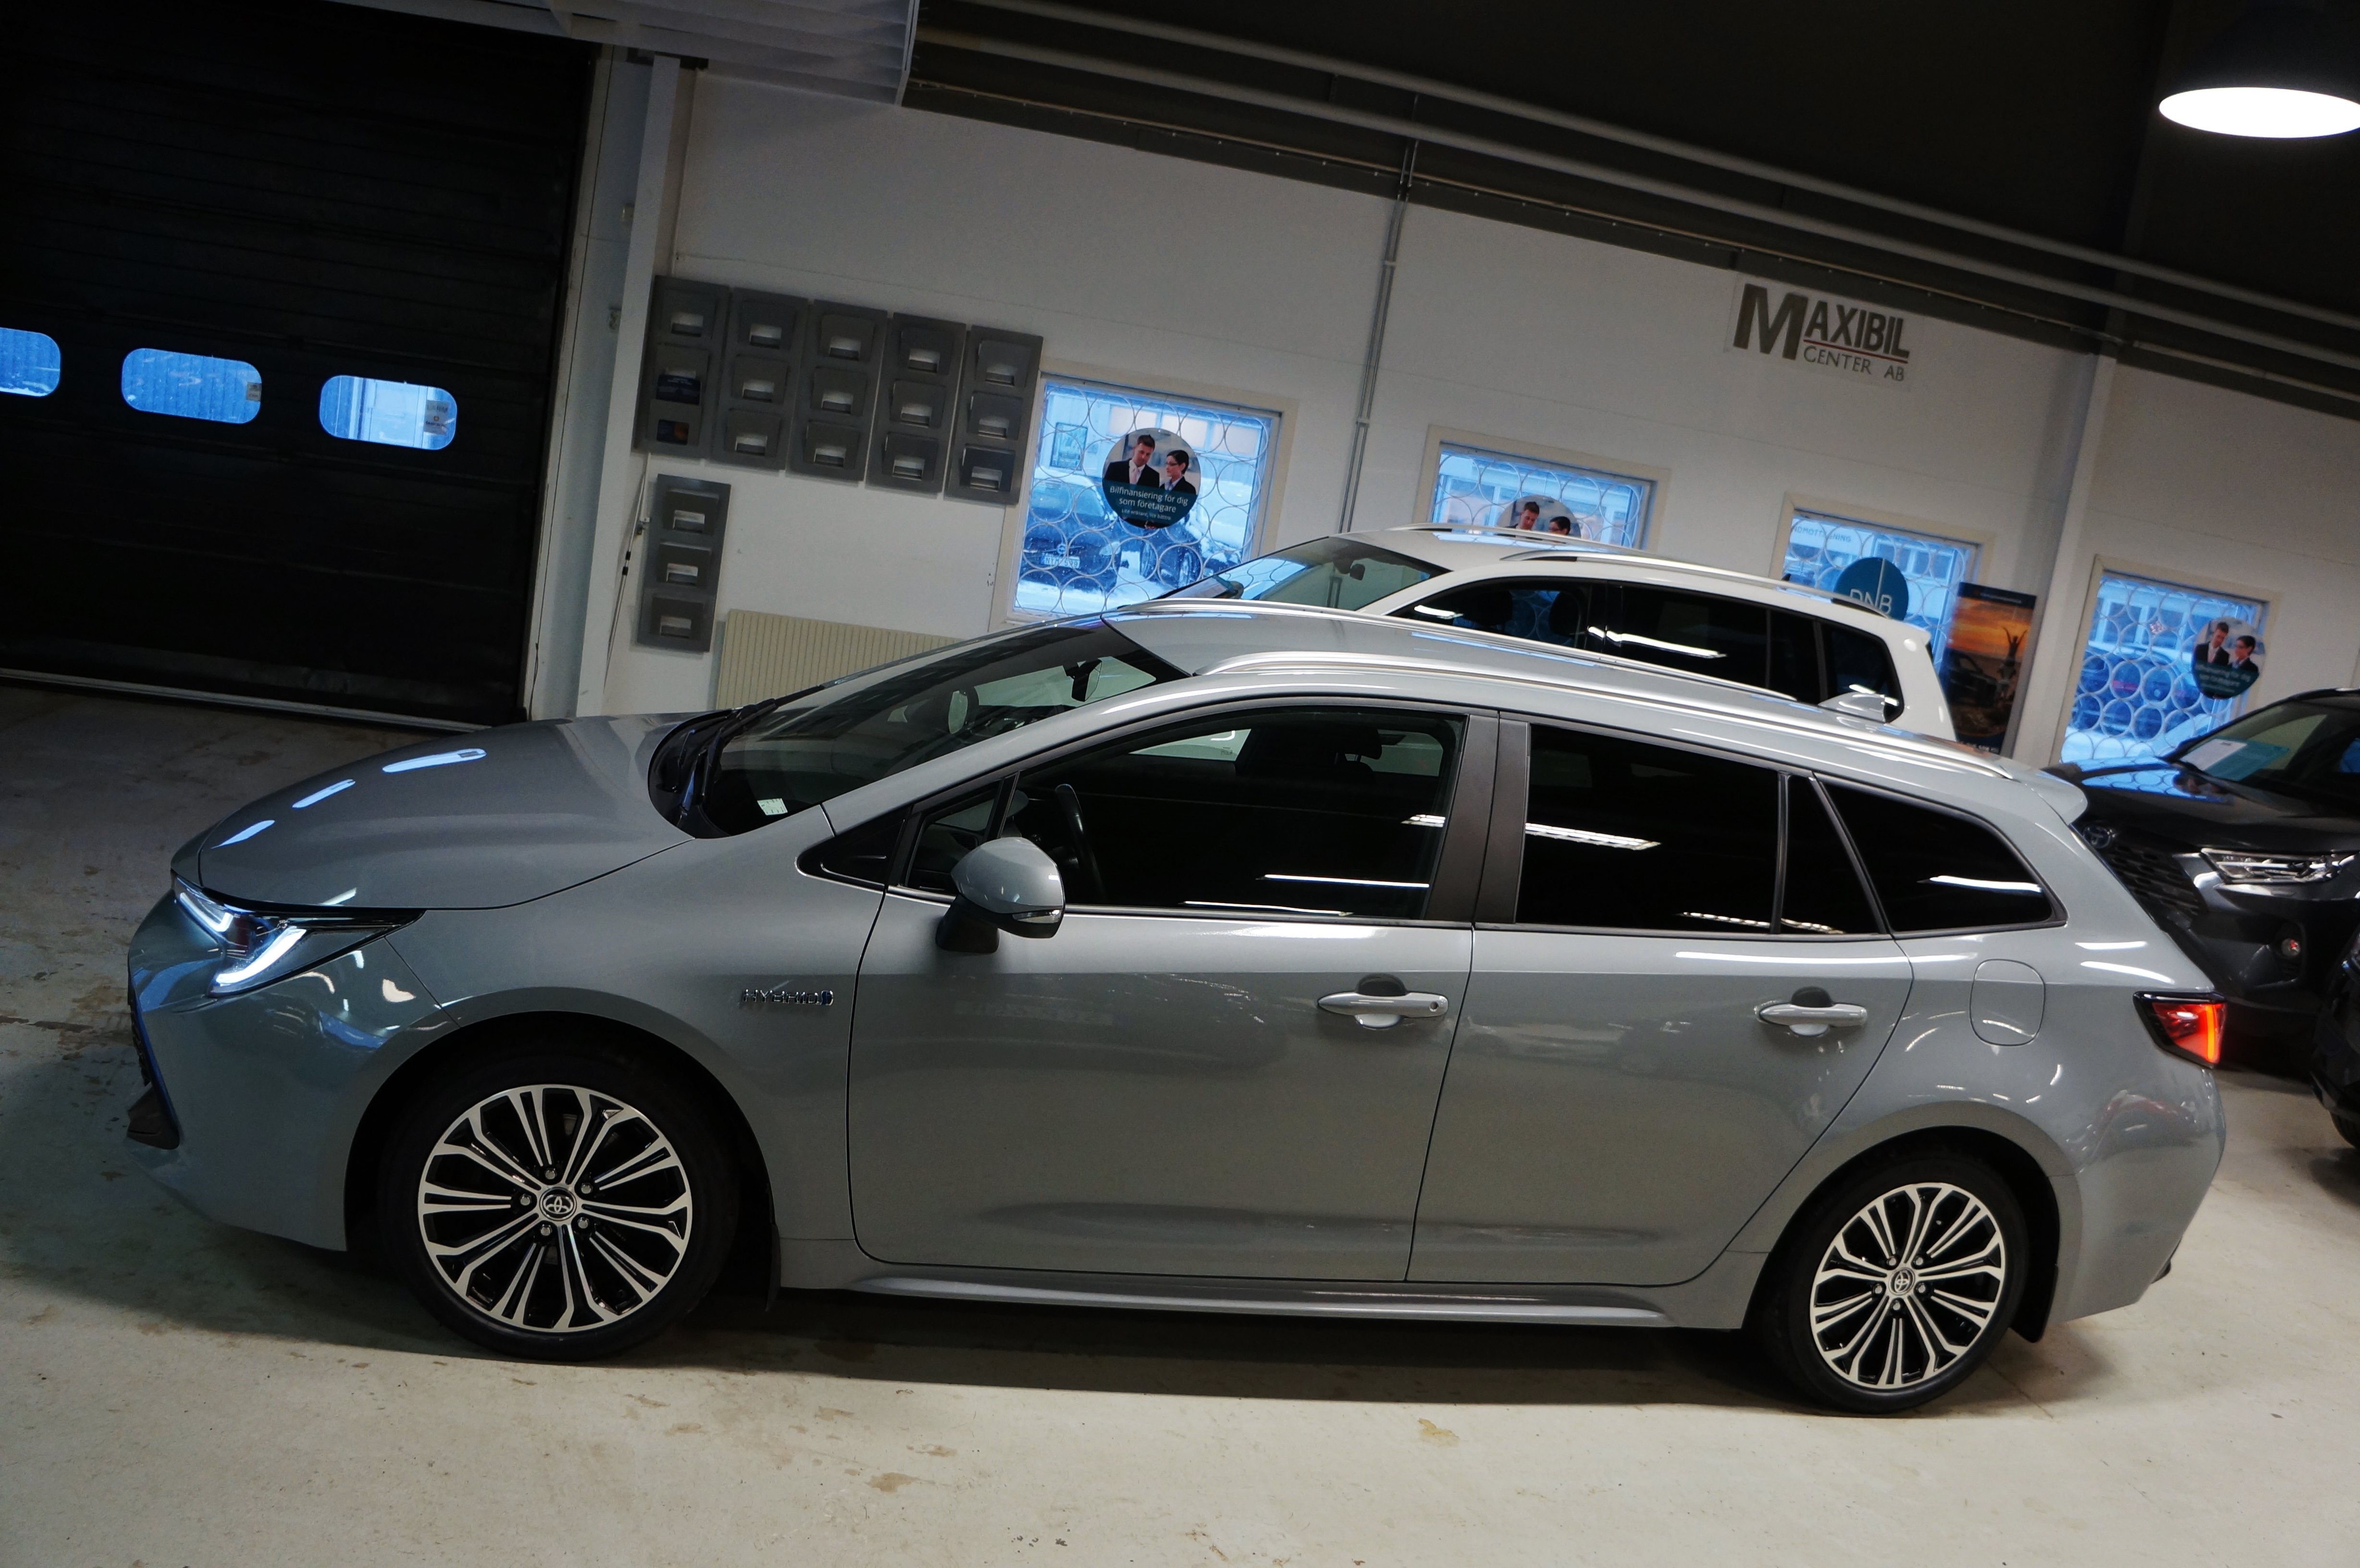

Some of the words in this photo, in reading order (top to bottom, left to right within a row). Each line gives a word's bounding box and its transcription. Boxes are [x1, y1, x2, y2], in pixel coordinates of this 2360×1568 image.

[1733, 283, 1910, 360] MAXIBIL
[1804, 345, 1871, 374] CENTER
[1884, 365, 1905, 381] AB
[1110, 486, 1163, 502] Bilfinansiering
[1165, 494, 1175, 503] för
[1177, 497, 1188, 506] dig
[1119, 498, 1135, 506] som
[1137, 499, 1176, 513] företagare
